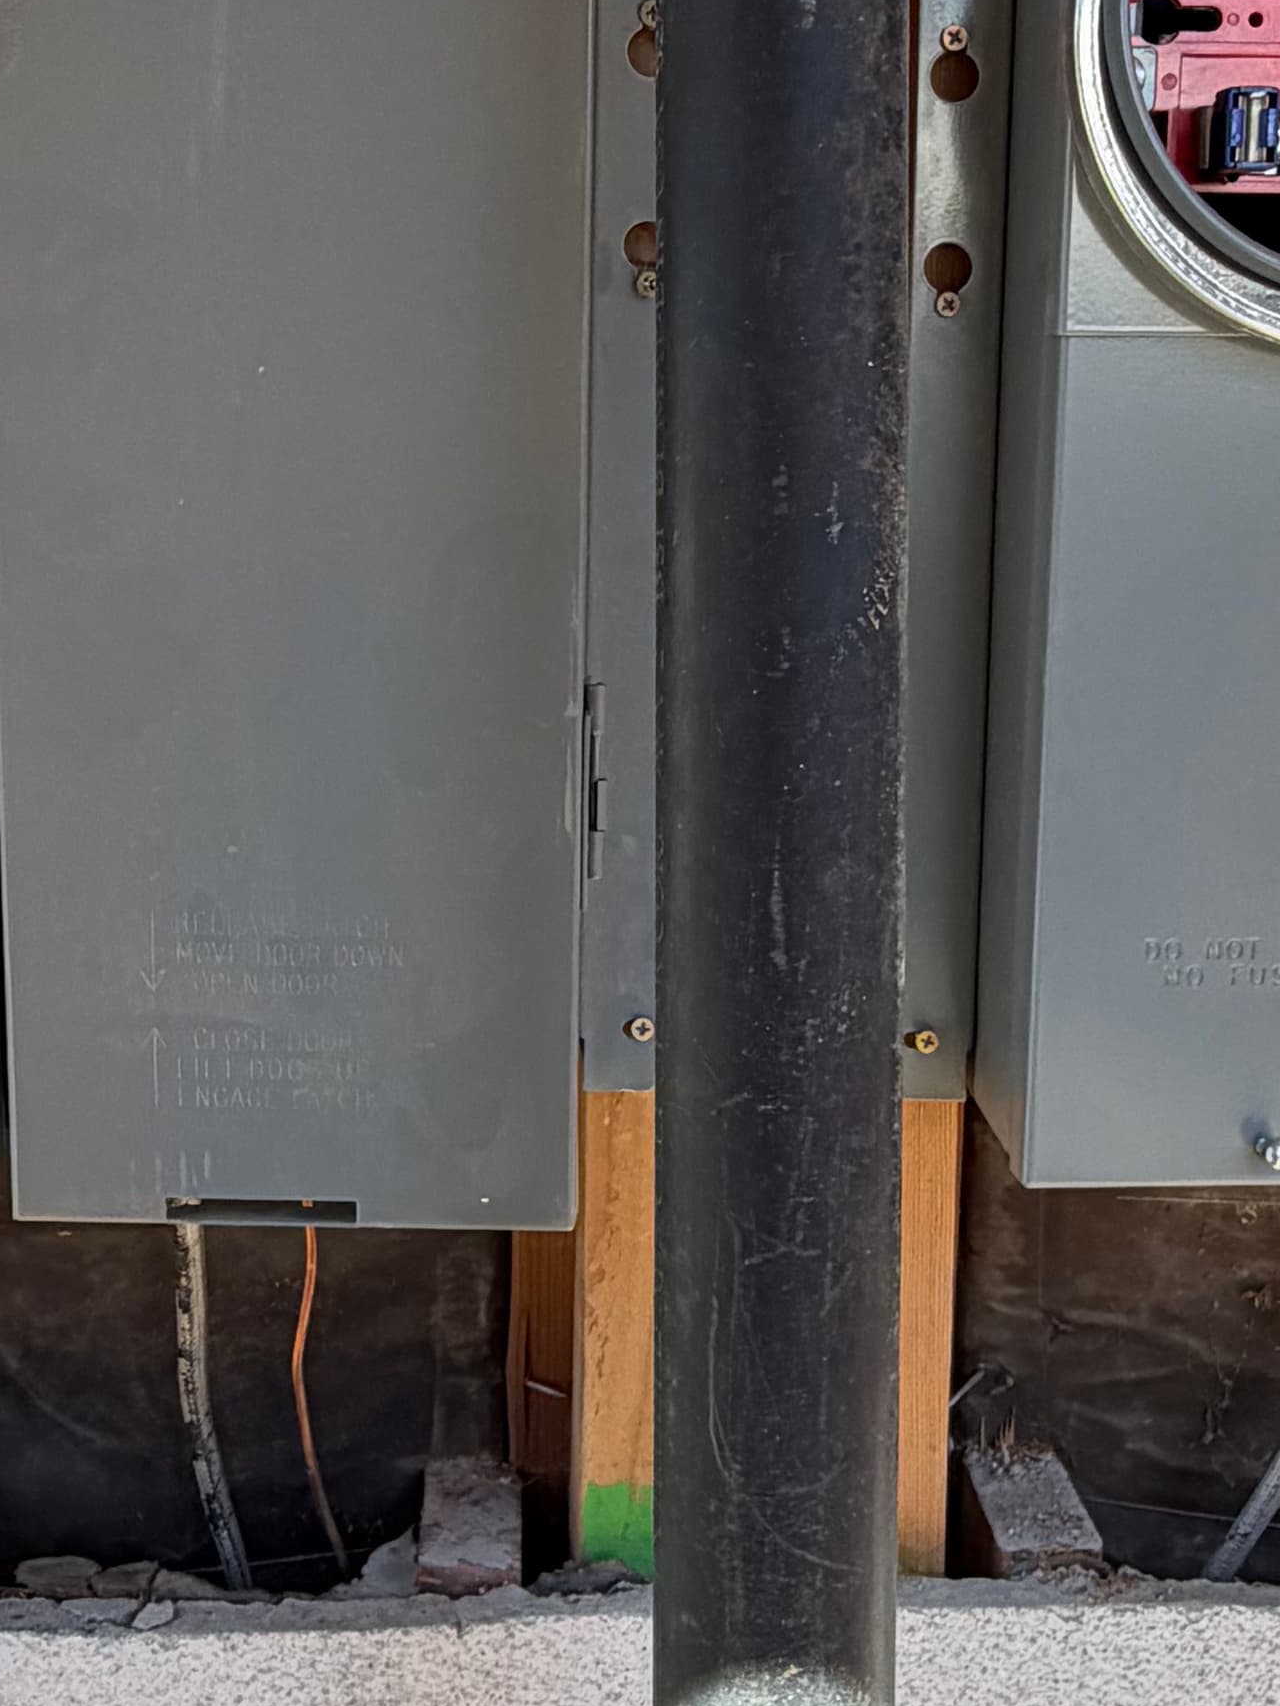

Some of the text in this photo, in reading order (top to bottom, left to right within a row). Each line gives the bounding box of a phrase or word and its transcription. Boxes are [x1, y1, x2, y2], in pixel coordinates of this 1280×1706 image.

[333, 942, 404, 967] DOWN
[1143, 937, 1184, 962] DO
[1205, 936, 1262, 961] NOT
[271, 972, 338, 996] DOOR
[1162, 963, 1205, 987] NO
